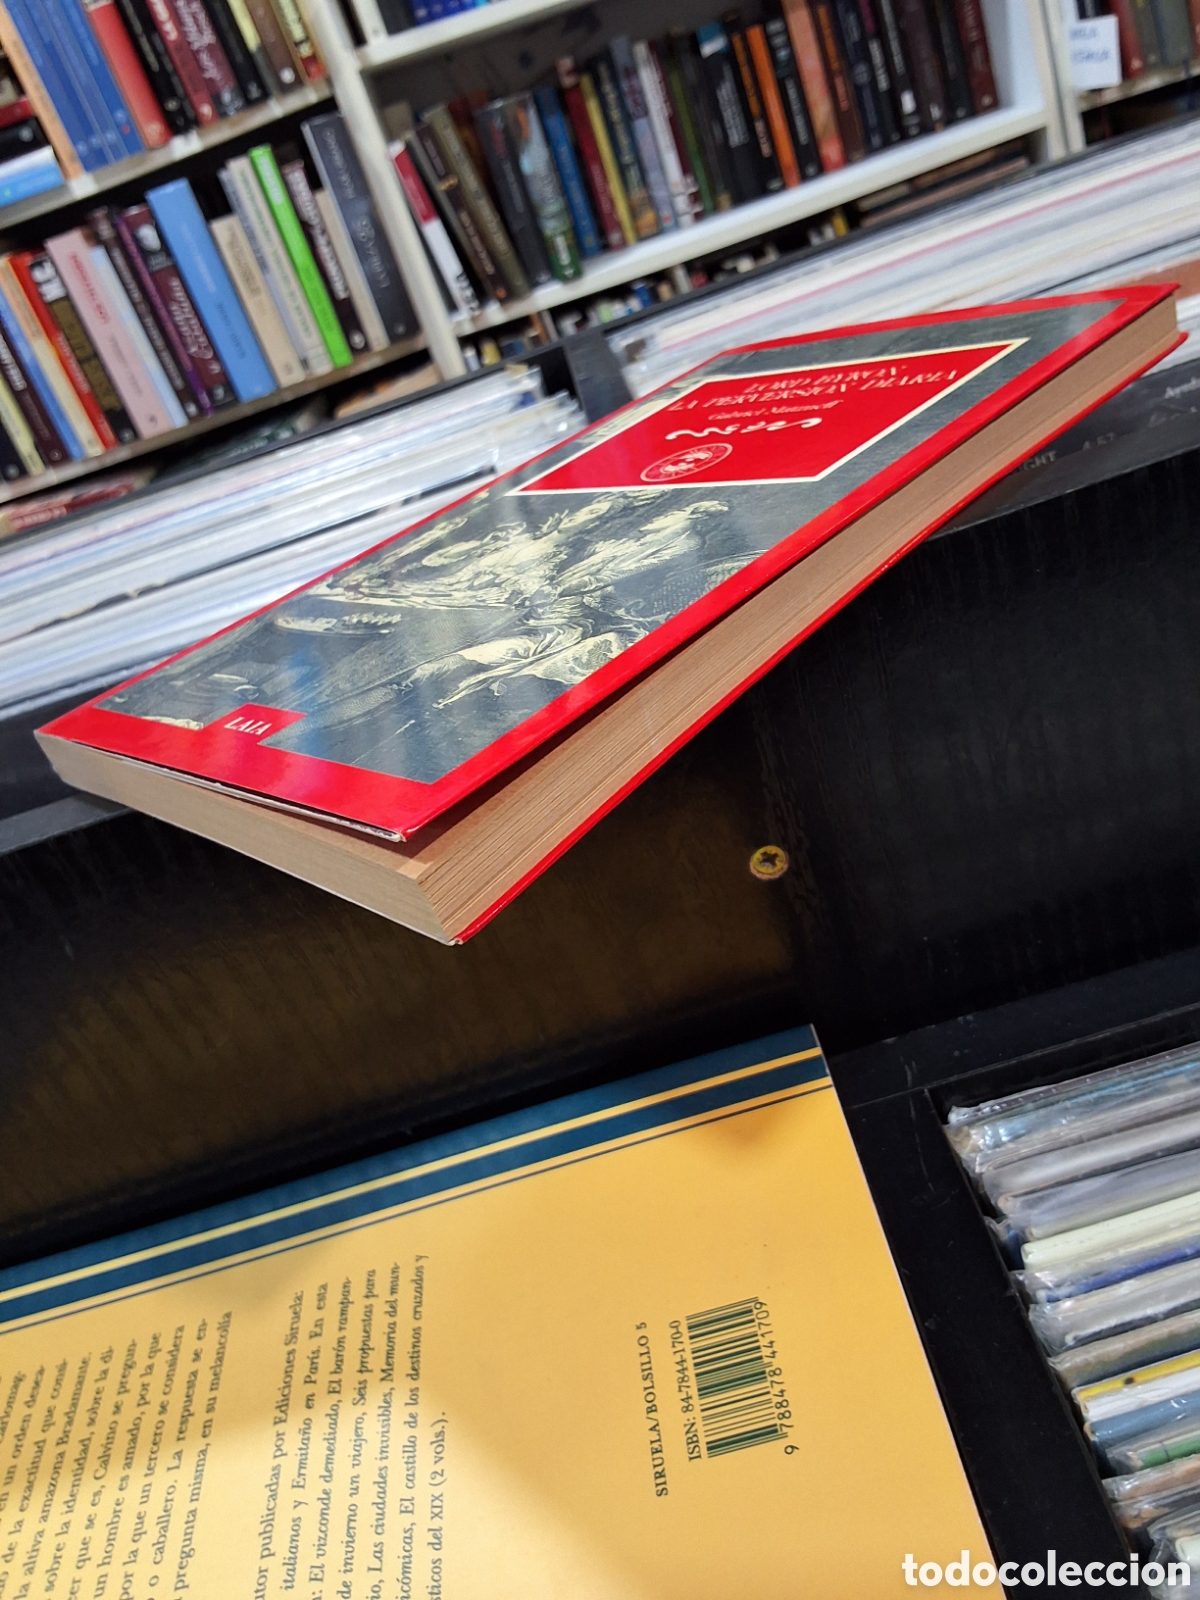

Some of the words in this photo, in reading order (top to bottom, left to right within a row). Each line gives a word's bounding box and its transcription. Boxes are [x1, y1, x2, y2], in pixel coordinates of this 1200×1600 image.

[222, 716, 273, 735] LAIA
[414, 1254, 429, 1263] y
[362, 1268, 379, 1300] para
[388, 1262, 400, 1296] mun-
[410, 1264, 424, 1321] cruzados
[315, 1282, 328, 1311] esta
[337, 1276, 352, 1332] rampan-
[383, 1297, 398, 1318] del
[195, 1318, 207, 1341] en-
[283, 1290, 304, 1346] Siruela:
[307, 1317, 324, 1340] En
[636, 1321, 647, 1331] 5
[99, 1345, 114, 1364] di-
[147, 1332, 162, 1359] que
[208, 1310, 232, 1392] melancolía
[328, 1334, 346, 1375] barón
[355, 1302, 375, 1375] propuestas
[378, 1320, 397, 1383] Memoria
[404, 1325, 422, 1382] destinos
[116, 1338, 137, 1396] pregun-
[139, 1362, 154, 1378] la
[161, 1324, 185, 1396] considera
[191, 1347, 203, 1363] se
[302, 1345, 321, 1385] París.
[669, 1320, 695, 1414] 84-7844-170-0
[93, 1367, 109, 1383] la
[272, 1347, 296, 1426] Ediciones
[326, 1377, 342, 1395] El
[85, 1386, 105, 1427] sobre
[111, 1400, 123, 1416] se
[135, 1382, 150, 1408] por
[157, 1400, 169, 1416] se
[175, 1368, 198, 1442] respuesta
[204, 1395, 217, 1414] su
[304, 1391, 316, 1410] en
[351, 1378, 368, 1406] Seis
[403, 1386, 419, 1407] los
[200, 1417, 213, 1439] en
[374, 1386, 395, 1461] invisibles,
[402, 1411, 419, 1429] de
[637, 1335, 668, 1497] SIRUELA/BOLSILLO
[92, 1419, 118, 1481] Calvino
[121, 1410, 145, 1471] amado,
[142, 1418, 165, 1478] tercero
[272, 1429, 288, 1459] por
[290, 1416, 313, 1489] Ermitaño
[318, 1398, 343, 1483] demediado,
[347, 1411, 367, 1469] viajero,
[429, 1411, 448, 1465] vols.).
[683, 1416, 702, 1462] ISBN:
[60, 1430, 95, 1515] identidad,
[166, 1448, 183, 1472] La
[187, 1442, 211, 1503] misma,
[401, 1434, 417, 1489] castillo
[117, 1473, 130, 1492] es
[138, 1481, 152, 1505] un
[348, 1473, 360, 1498] un
[428, 1468, 446, 1487] (2
[89, 1484, 105, 1507] es,
[257, 1463, 281, 1560] publicadas
[292, 1499, 307, 1509] y
[369, 1464, 388, 1536] ciudades
[398, 1495, 415, 1515] El
[429, 1492, 443, 1520] XIX
[12, 1581, 30, 1600] la
[21, 1528, 45, 1576] altiva
[38, 1450, 66, 1523] amazona
[54, 1519, 71, 1537] la
[84, 1513, 97, 1530] se
[95, 1496, 124, 1568] hombre
[130, 1510, 147, 1543] que
[151, 1479, 177, 1565] caballero.
[311, 1487, 331, 1559] vizconde
[74, 1536, 91, 1570] que
[173, 1506, 197, 1592] pregunta
[279, 1515, 302, 1591] italianos
[337, 1502, 358, 1574] invierno
[426, 1525, 443, 1551] del
[43, 1542, 65, 1592] sobre
[121, 1547, 139, 1566] la
[307, 1562, 325, 1582] El
[366, 1540, 384, 1573] Las
[93, 1572, 108, 1599] un
[118, 1571, 134, 1600] por
[147, 1574, 159, 1587] o
[335, 1579, 352, 1600] de
